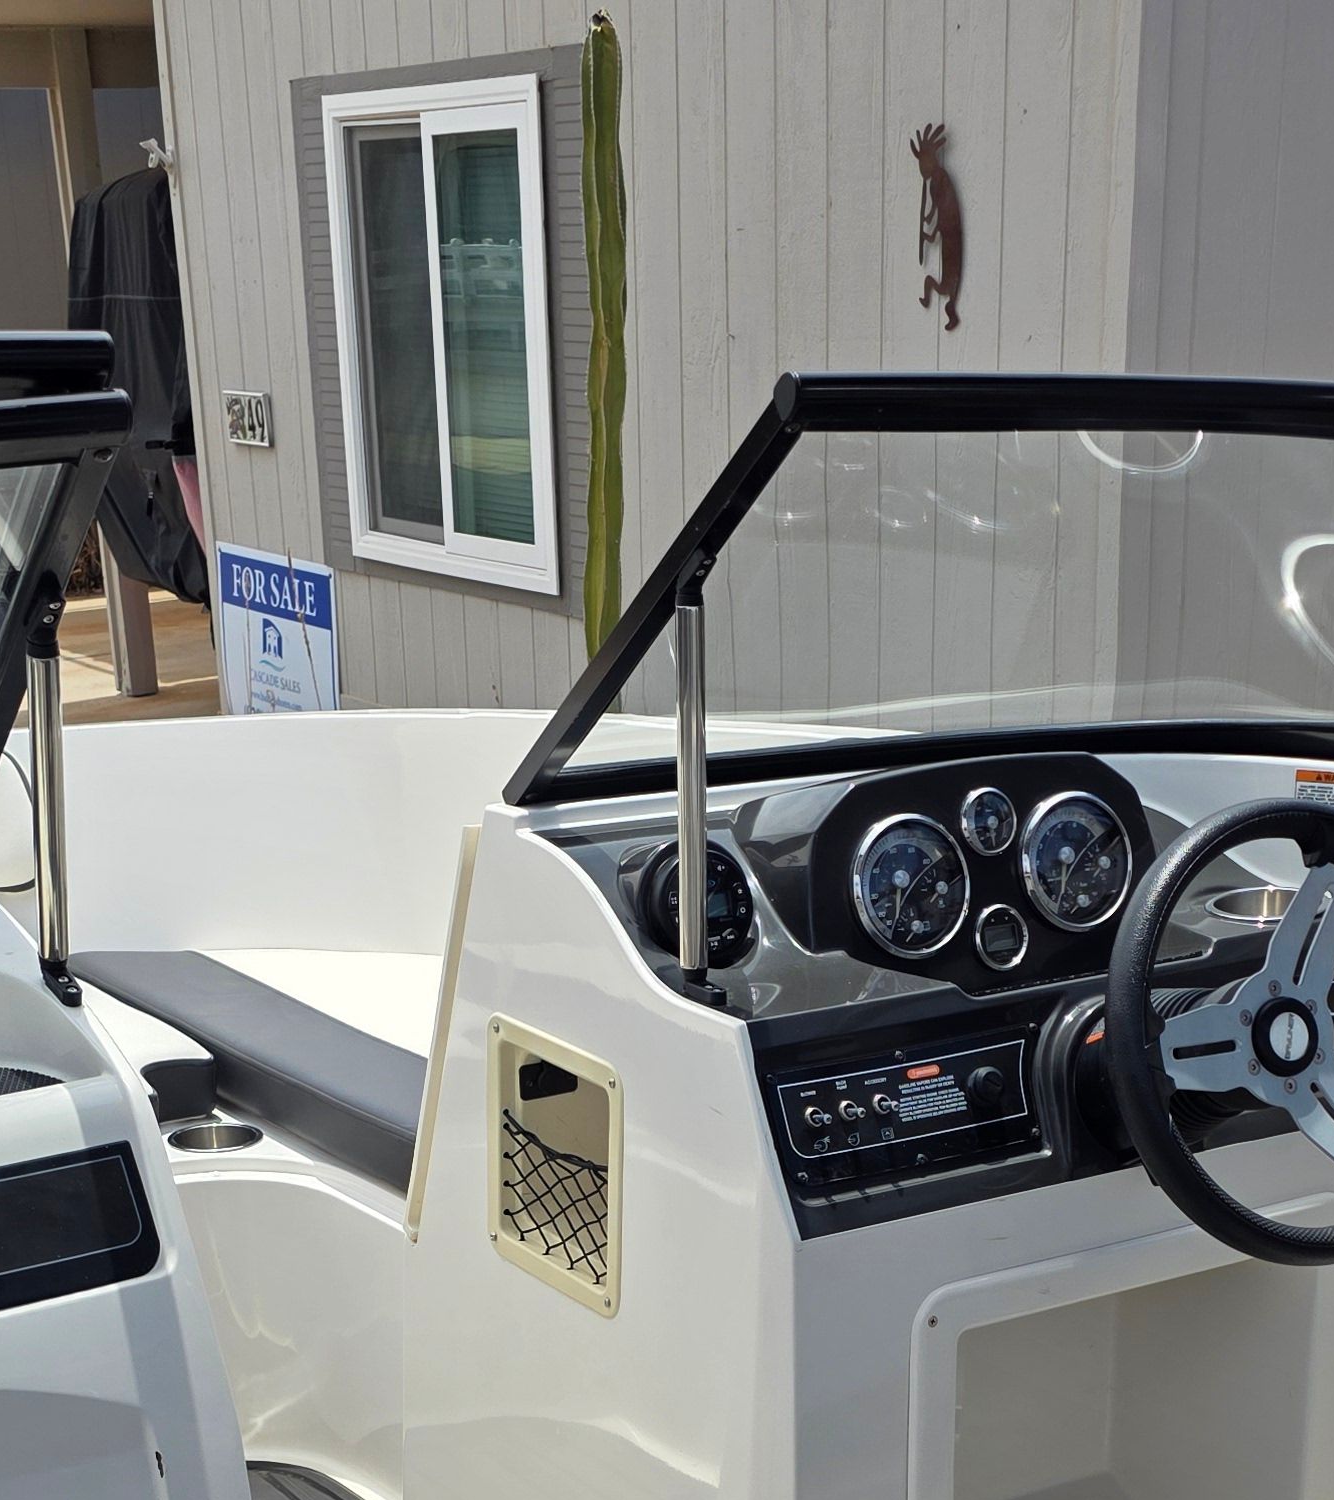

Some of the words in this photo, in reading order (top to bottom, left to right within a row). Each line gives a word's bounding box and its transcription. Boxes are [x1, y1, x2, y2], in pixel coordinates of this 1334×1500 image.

[248, 399, 265, 442] 49
[232, 563, 267, 605] FOR
[270, 573, 316, 616] SALE
[281, 677, 301, 694] SALES
